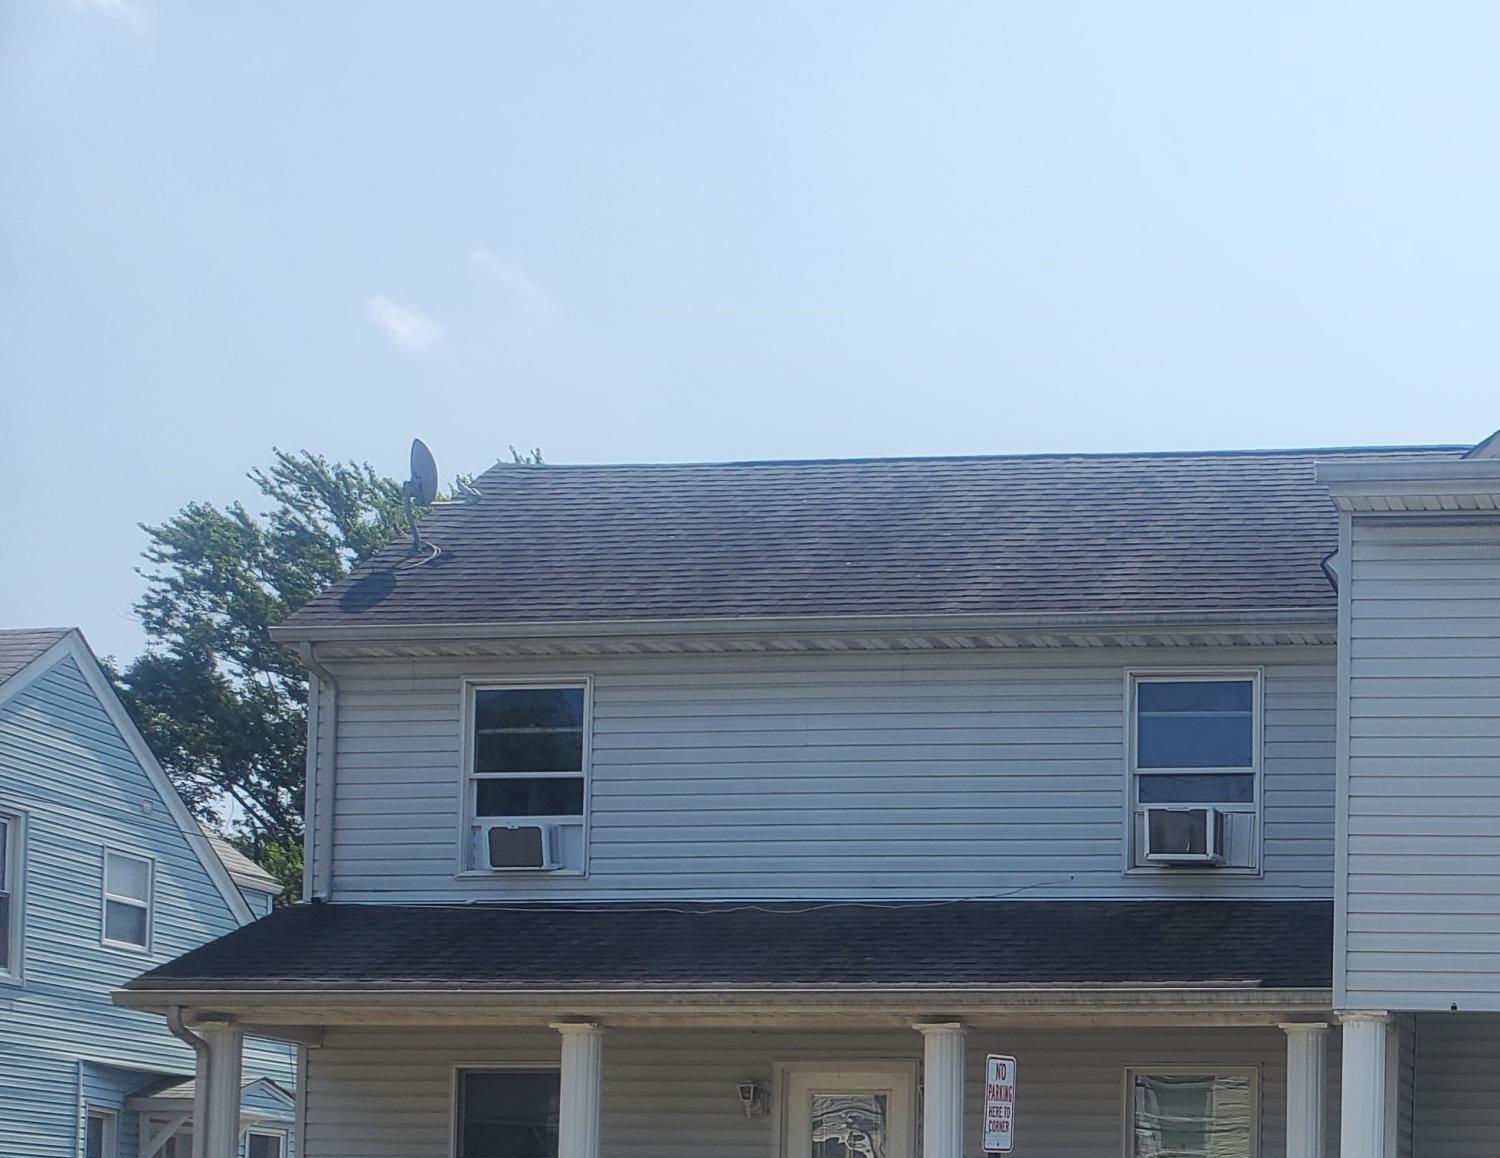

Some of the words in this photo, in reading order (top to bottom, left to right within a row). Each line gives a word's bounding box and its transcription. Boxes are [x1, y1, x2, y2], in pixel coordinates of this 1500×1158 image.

[995, 1063, 1007, 1080] NO
[988, 1084, 1013, 1102] PARKING
[988, 1106, 1002, 1118] HERE
[1003, 1106, 1011, 1119] TO
[988, 1121, 1010, 1133] CORNER
